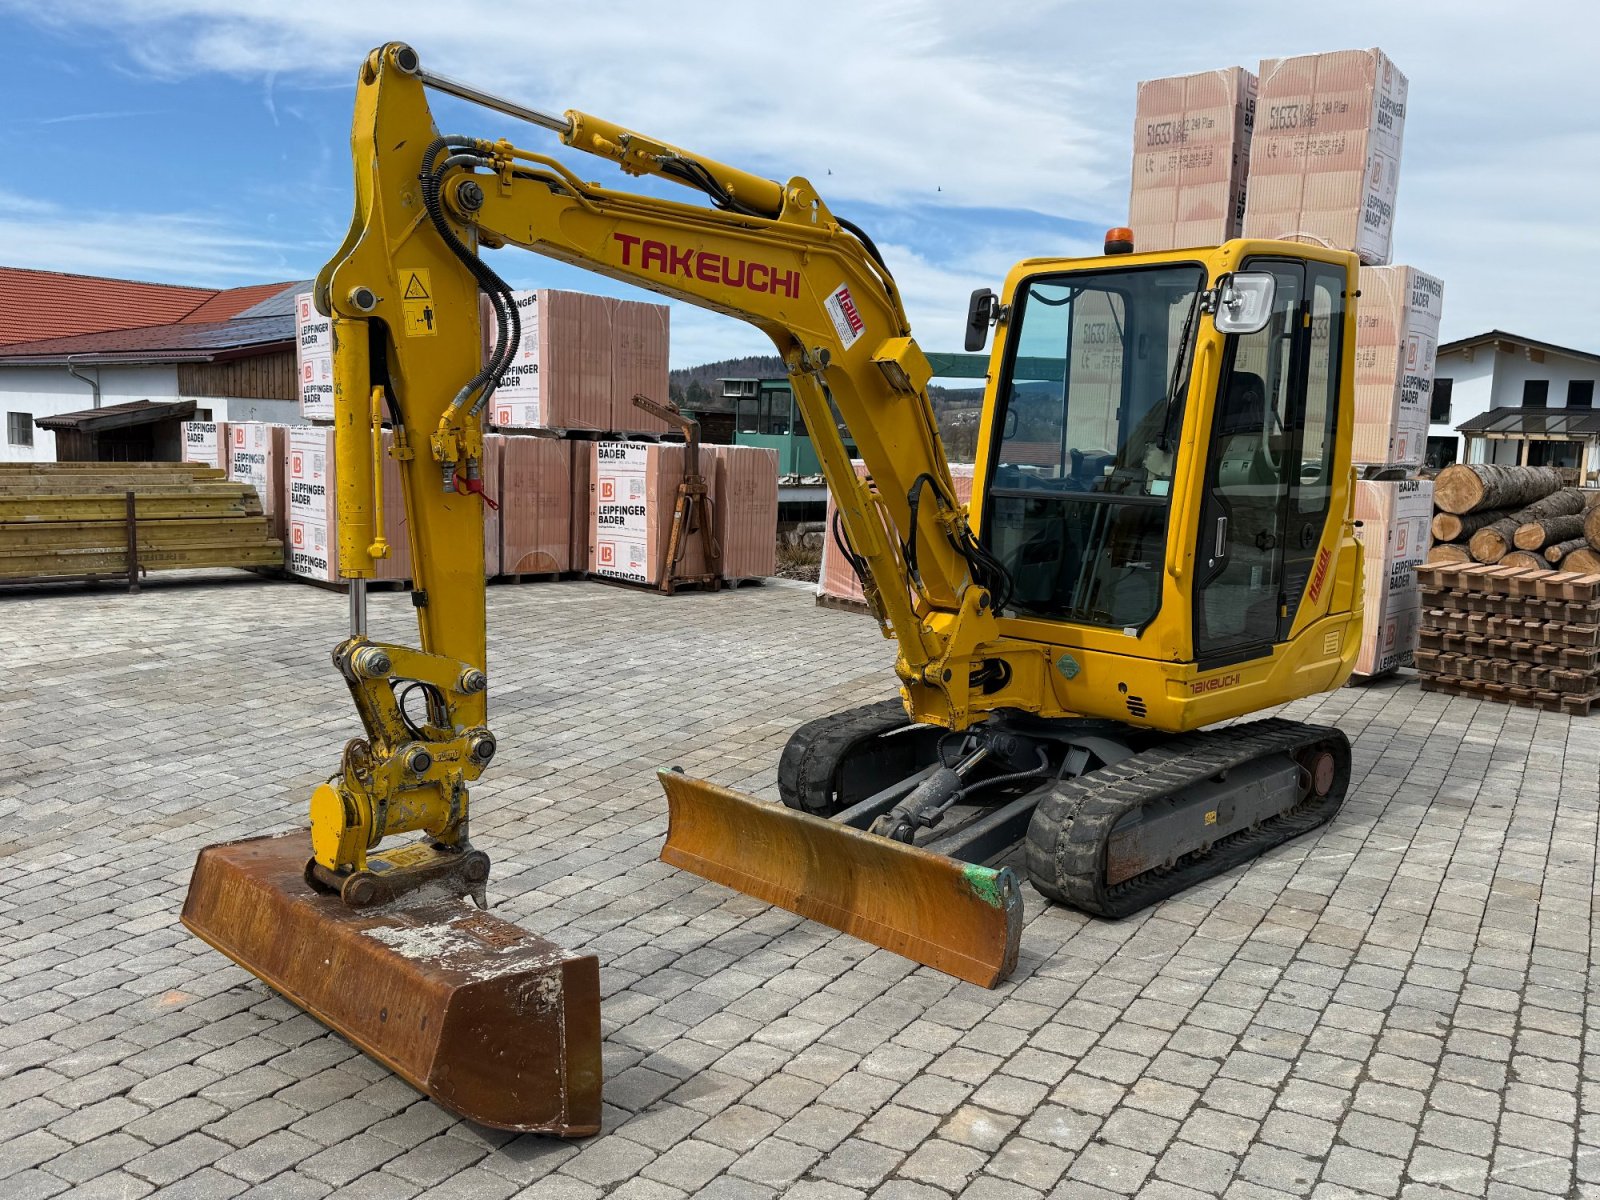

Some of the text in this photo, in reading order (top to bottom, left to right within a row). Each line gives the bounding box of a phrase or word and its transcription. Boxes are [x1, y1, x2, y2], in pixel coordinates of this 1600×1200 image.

[1270, 105, 1298, 130] 51633
[1146, 123, 1171, 147] 51633
[613, 232, 800, 299] TAKEUCHI
[1412, 274, 1442, 299] LEIPFINGER
[1411, 291, 1429, 309] BADER
[301, 322, 329, 336] LEIPFINGER
[302, 335, 318, 346] BADER
[500, 376, 521, 387] ADER
[1402, 375, 1430, 392] LEIPFINGER
[304, 385, 333, 394] LEIPFINGER
[304, 394, 321, 403] BADER
[1401, 389, 1419, 405] BADER
[186, 422, 217, 433] LEIPFINGER
[187, 433, 204, 442] BADER
[234, 452, 266, 464] LEIPFINGER
[598, 449, 626, 459] BADER
[234, 463, 252, 475] BADER
[291, 482, 326, 496] LEIPFINGER
[291, 493, 311, 505] BADER
[598, 506, 646, 516] LEIPFINGER
[598, 516, 626, 526] BADER
[291, 553, 328, 570] LEIPFINGER
[1390, 574, 1410, 590] BADER
